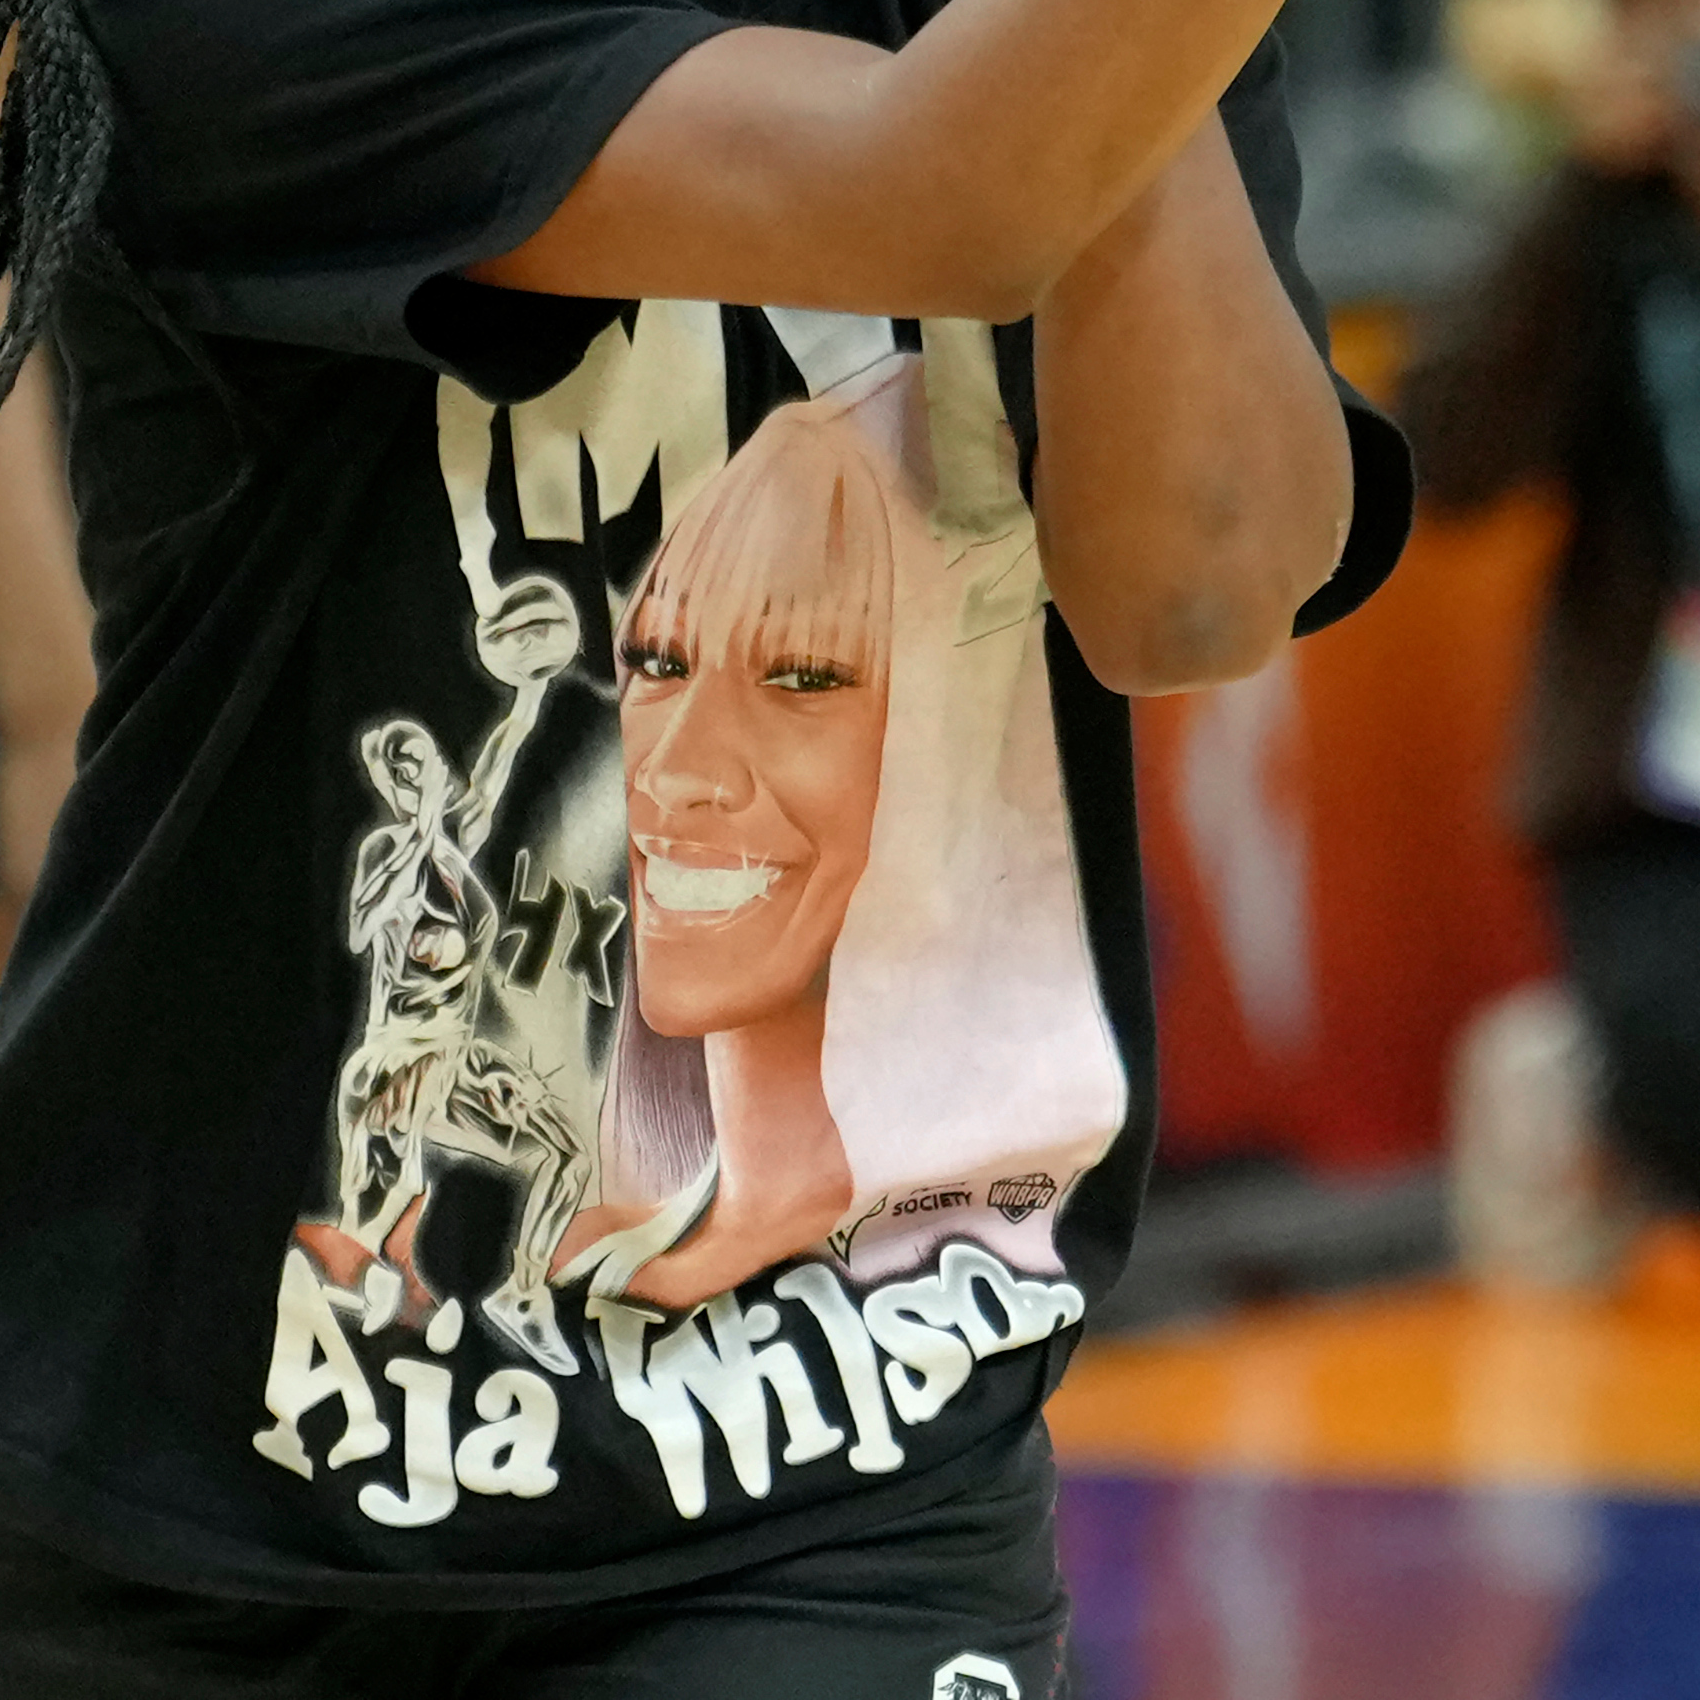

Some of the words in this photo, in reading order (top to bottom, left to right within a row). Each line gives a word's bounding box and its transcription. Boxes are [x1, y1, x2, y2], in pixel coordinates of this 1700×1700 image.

[892, 1191, 973, 1217] SOCIETY
[988, 1182, 1056, 1208] WNBPA
[253, 1248, 560, 1526] A'ja
